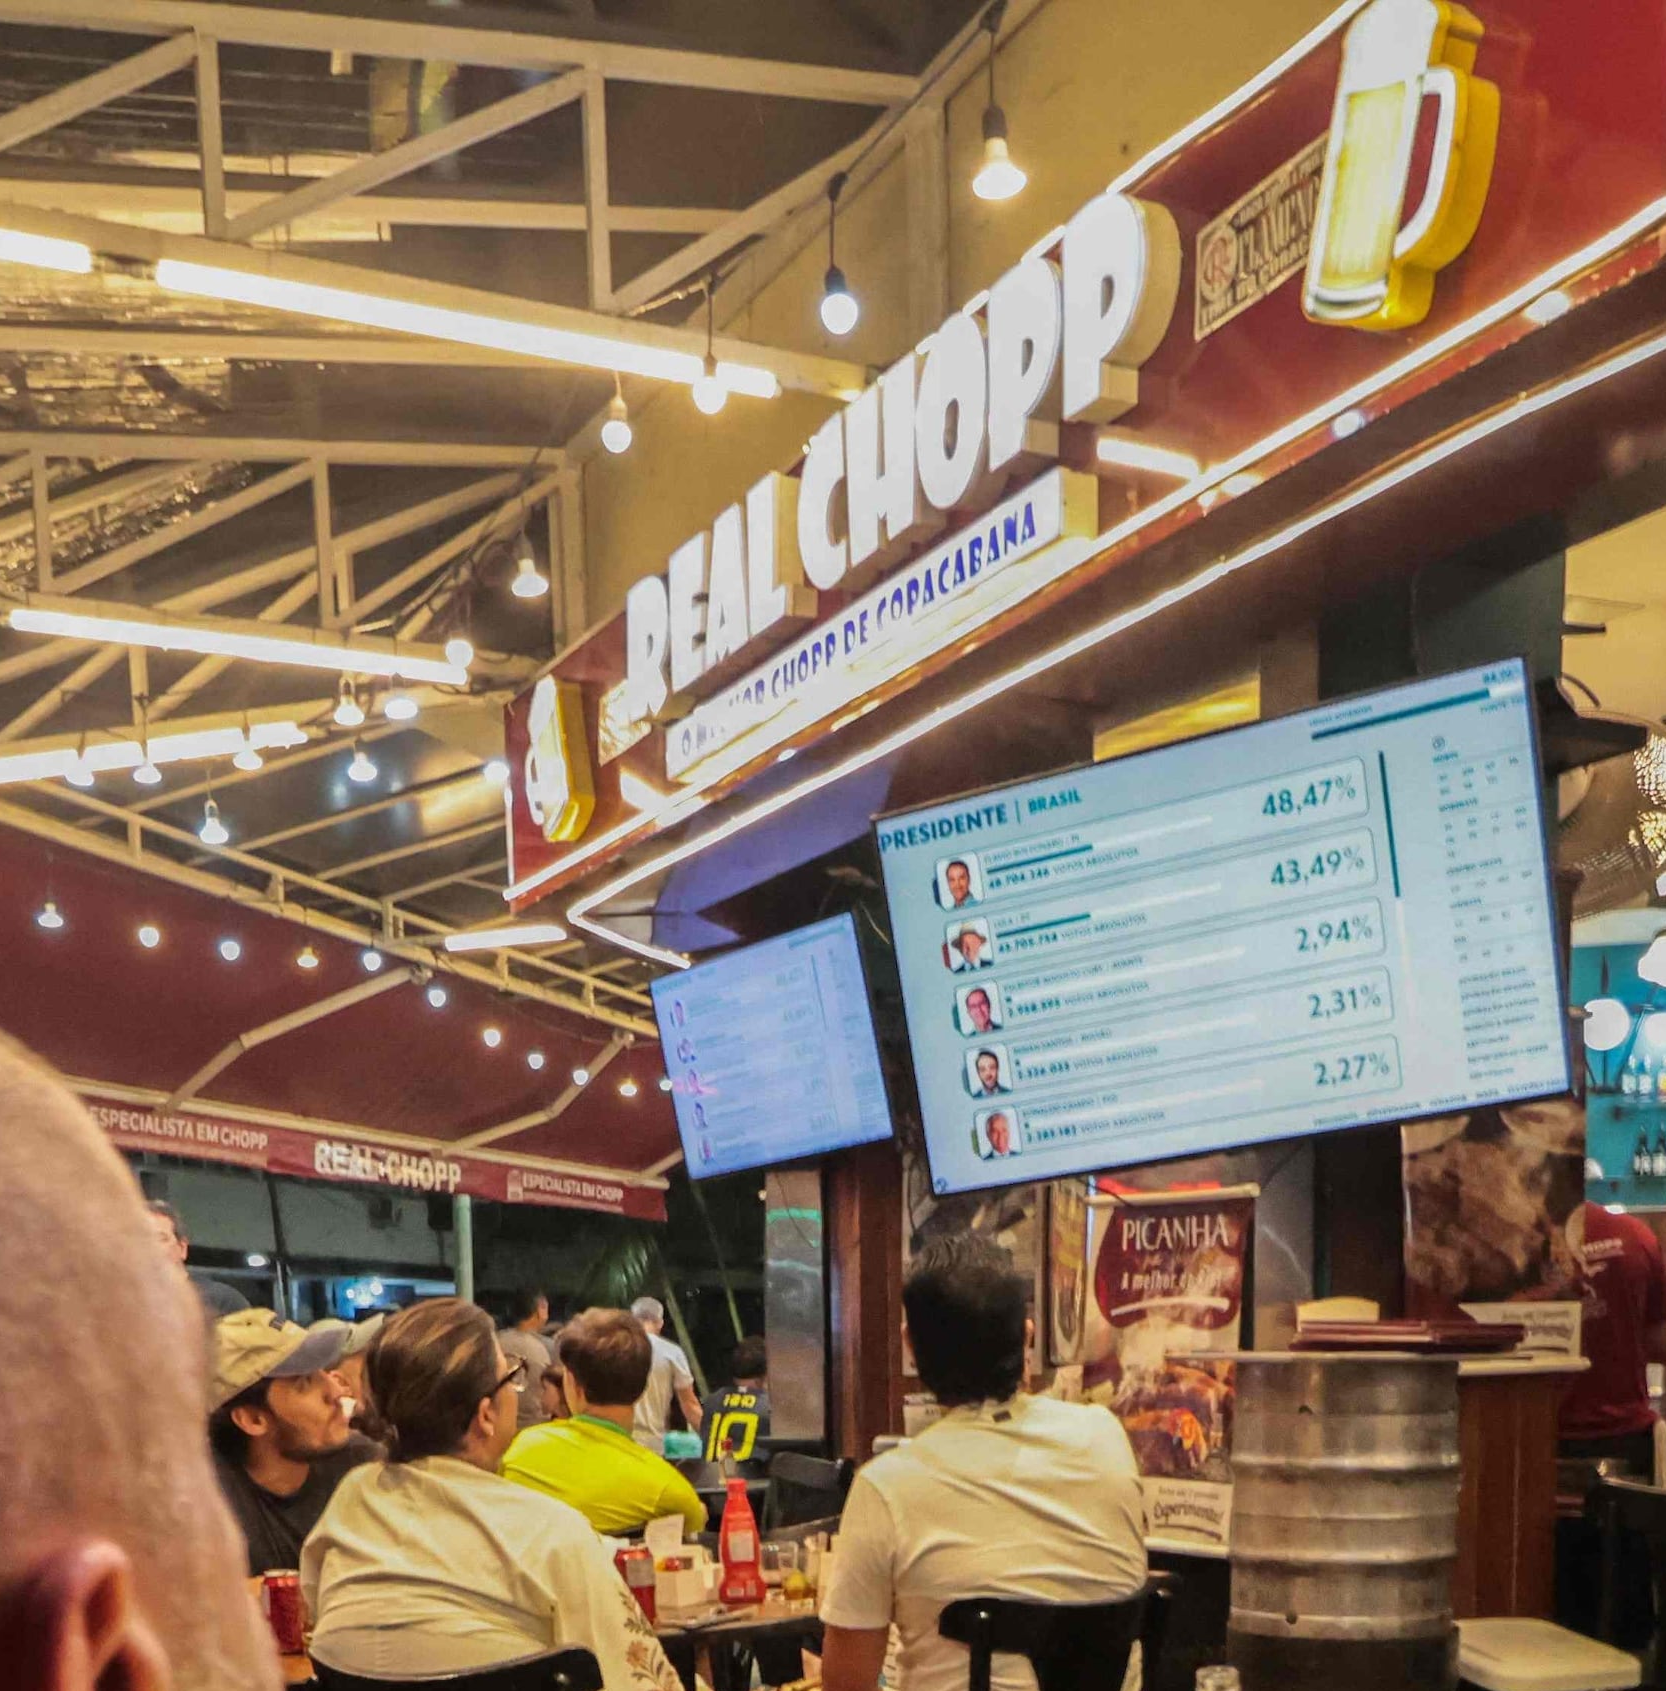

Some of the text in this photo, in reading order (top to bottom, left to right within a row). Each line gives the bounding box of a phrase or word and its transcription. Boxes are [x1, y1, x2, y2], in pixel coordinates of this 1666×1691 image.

[625, 193, 1145, 722] REAL CHOPP
[771, 631, 835, 699] CHOPP
[844, 609, 868, 656] DE
[876, 501, 1037, 632] COPACABANA
[1262, 773, 1356, 818] 48,47%
[880, 787, 1082, 853] PRESIDENTE BRASIL
[1271, 846, 1364, 886] 43,49%
[1296, 915, 1373, 952] 2,94%
[1307, 984, 1381, 1018] 2,31%
[1314, 1052, 1389, 1086] 2,27%
[90, 1106, 268, 1151] ESPECIALISTA EM CHOPP
[387, 1151, 462, 1193] CHOPP
[1122, 1213, 1229, 1251] PICANHA
[706, 1411, 759, 1462] 10
